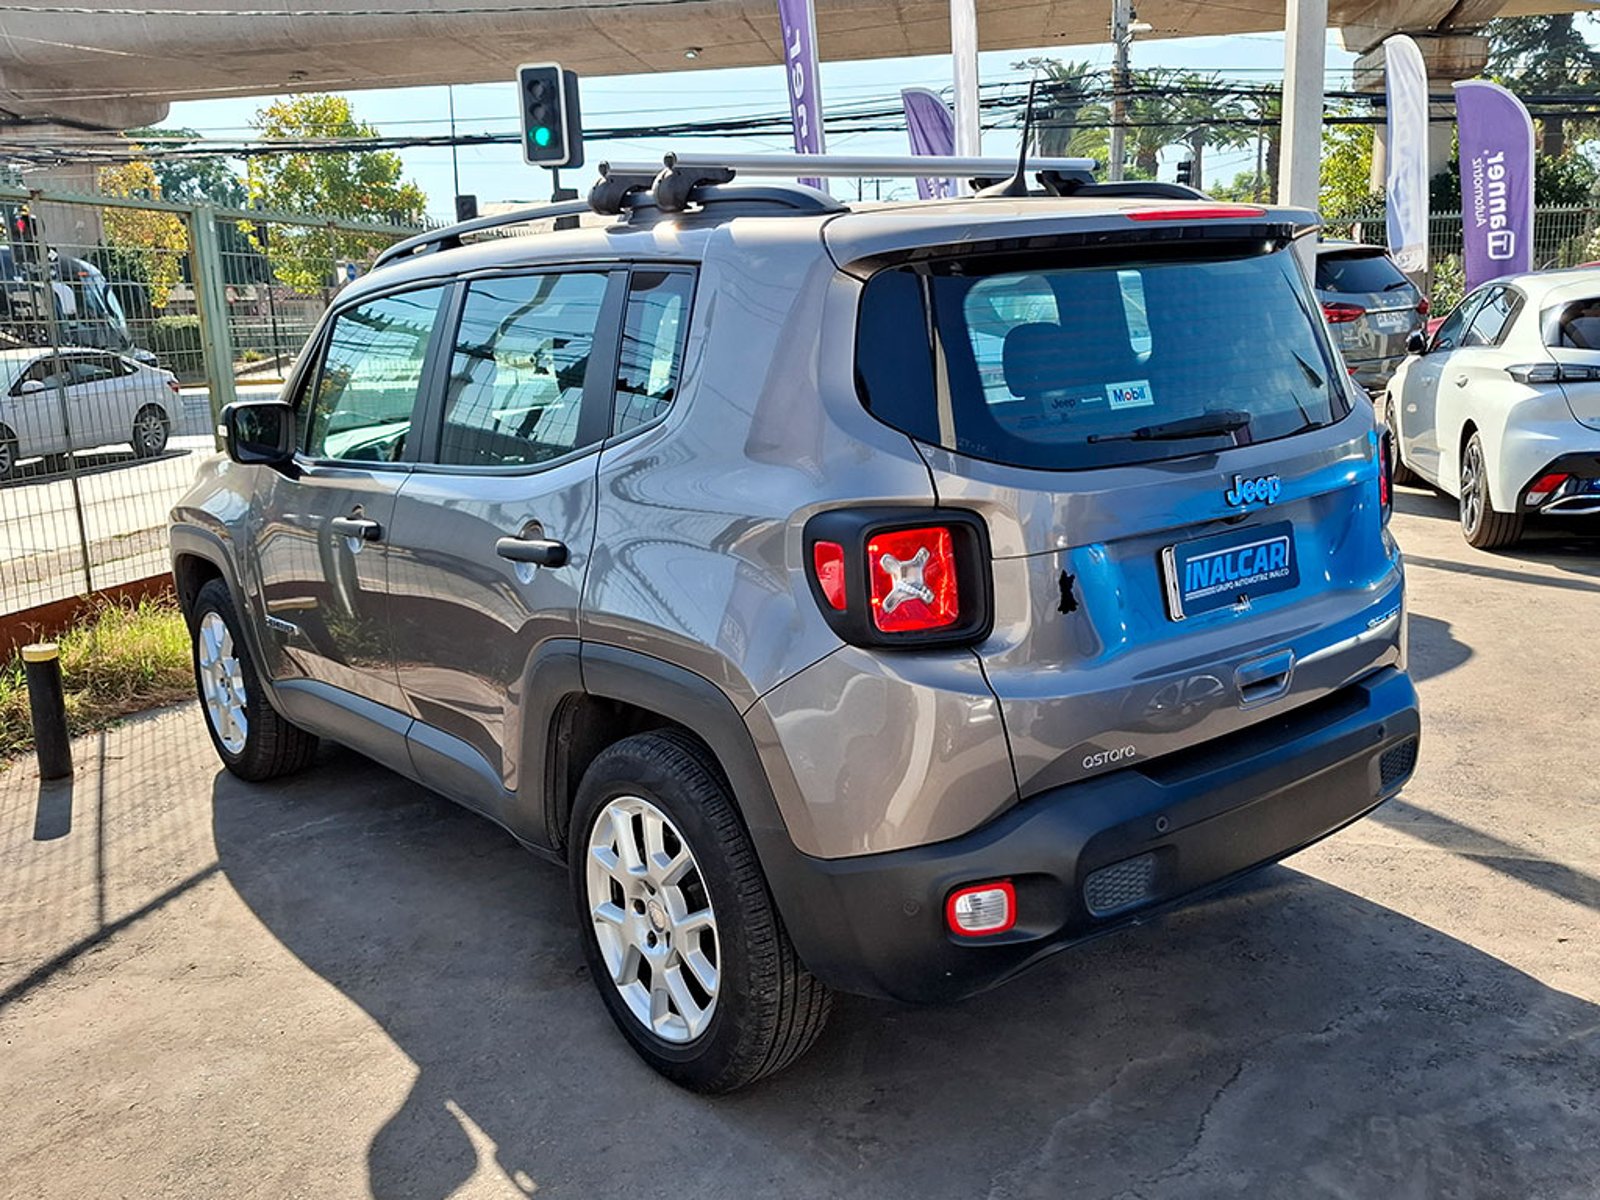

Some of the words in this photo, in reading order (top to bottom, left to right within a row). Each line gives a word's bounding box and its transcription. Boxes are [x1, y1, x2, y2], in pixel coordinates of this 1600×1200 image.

[1113, 387, 1146, 402] Mobil
[1226, 474, 1281, 505] Jeep
[1185, 542, 1285, 592] INALCAR
